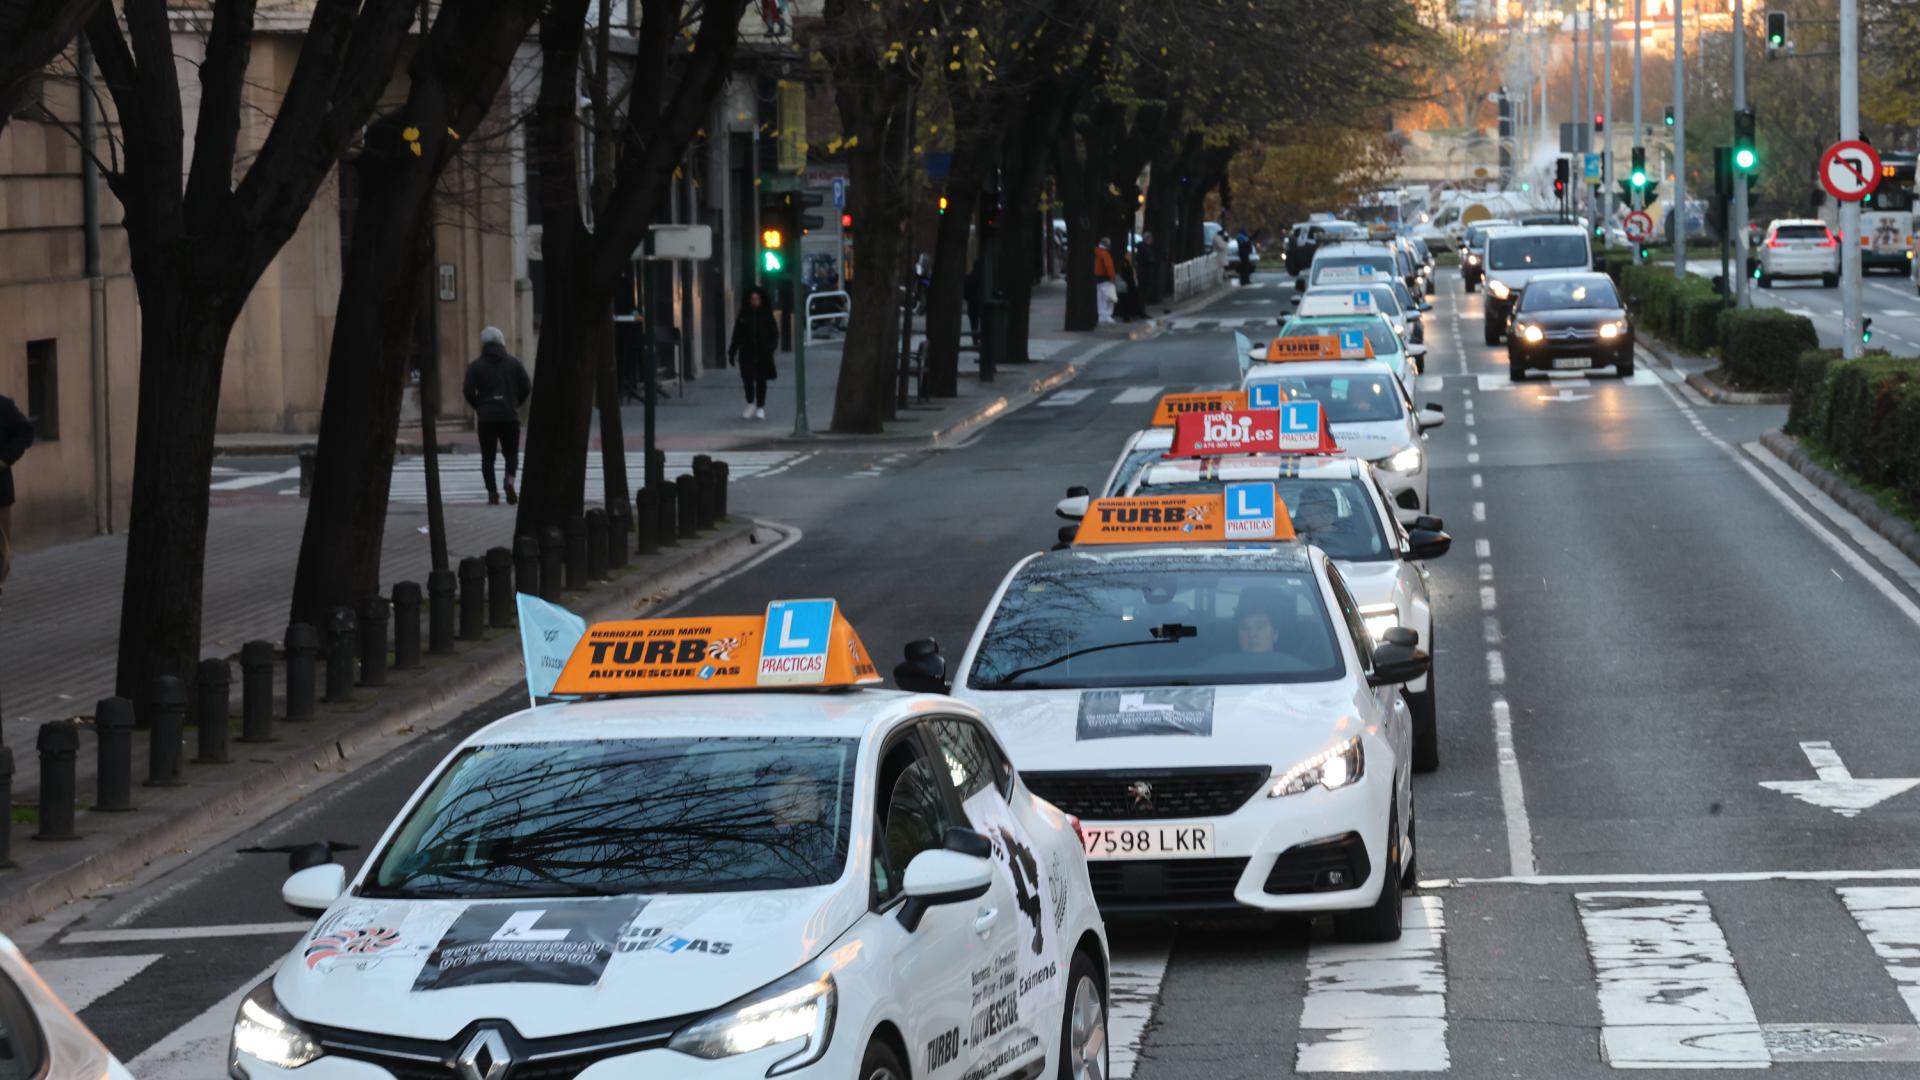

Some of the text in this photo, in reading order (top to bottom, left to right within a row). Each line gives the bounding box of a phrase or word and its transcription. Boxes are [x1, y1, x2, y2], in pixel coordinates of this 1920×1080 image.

[1345, 333, 1358, 347] L
[1256, 388, 1271, 405] L
[1203, 412, 1233, 422] moto
[1290, 407, 1308, 429] L
[1203, 416, 1274, 443] lobi.es
[1238, 490, 1261, 516] L
[1228, 520, 1272, 531] PRACTICAS
[591, 626, 712, 637] BERRIOZAR ZIZUR MAYOR
[779, 610, 810, 648] L
[762, 655, 823, 672] PRACTICAS
[1088, 829, 1206, 852] 7598 LKR
[927, 1025, 959, 1075] TURBO
